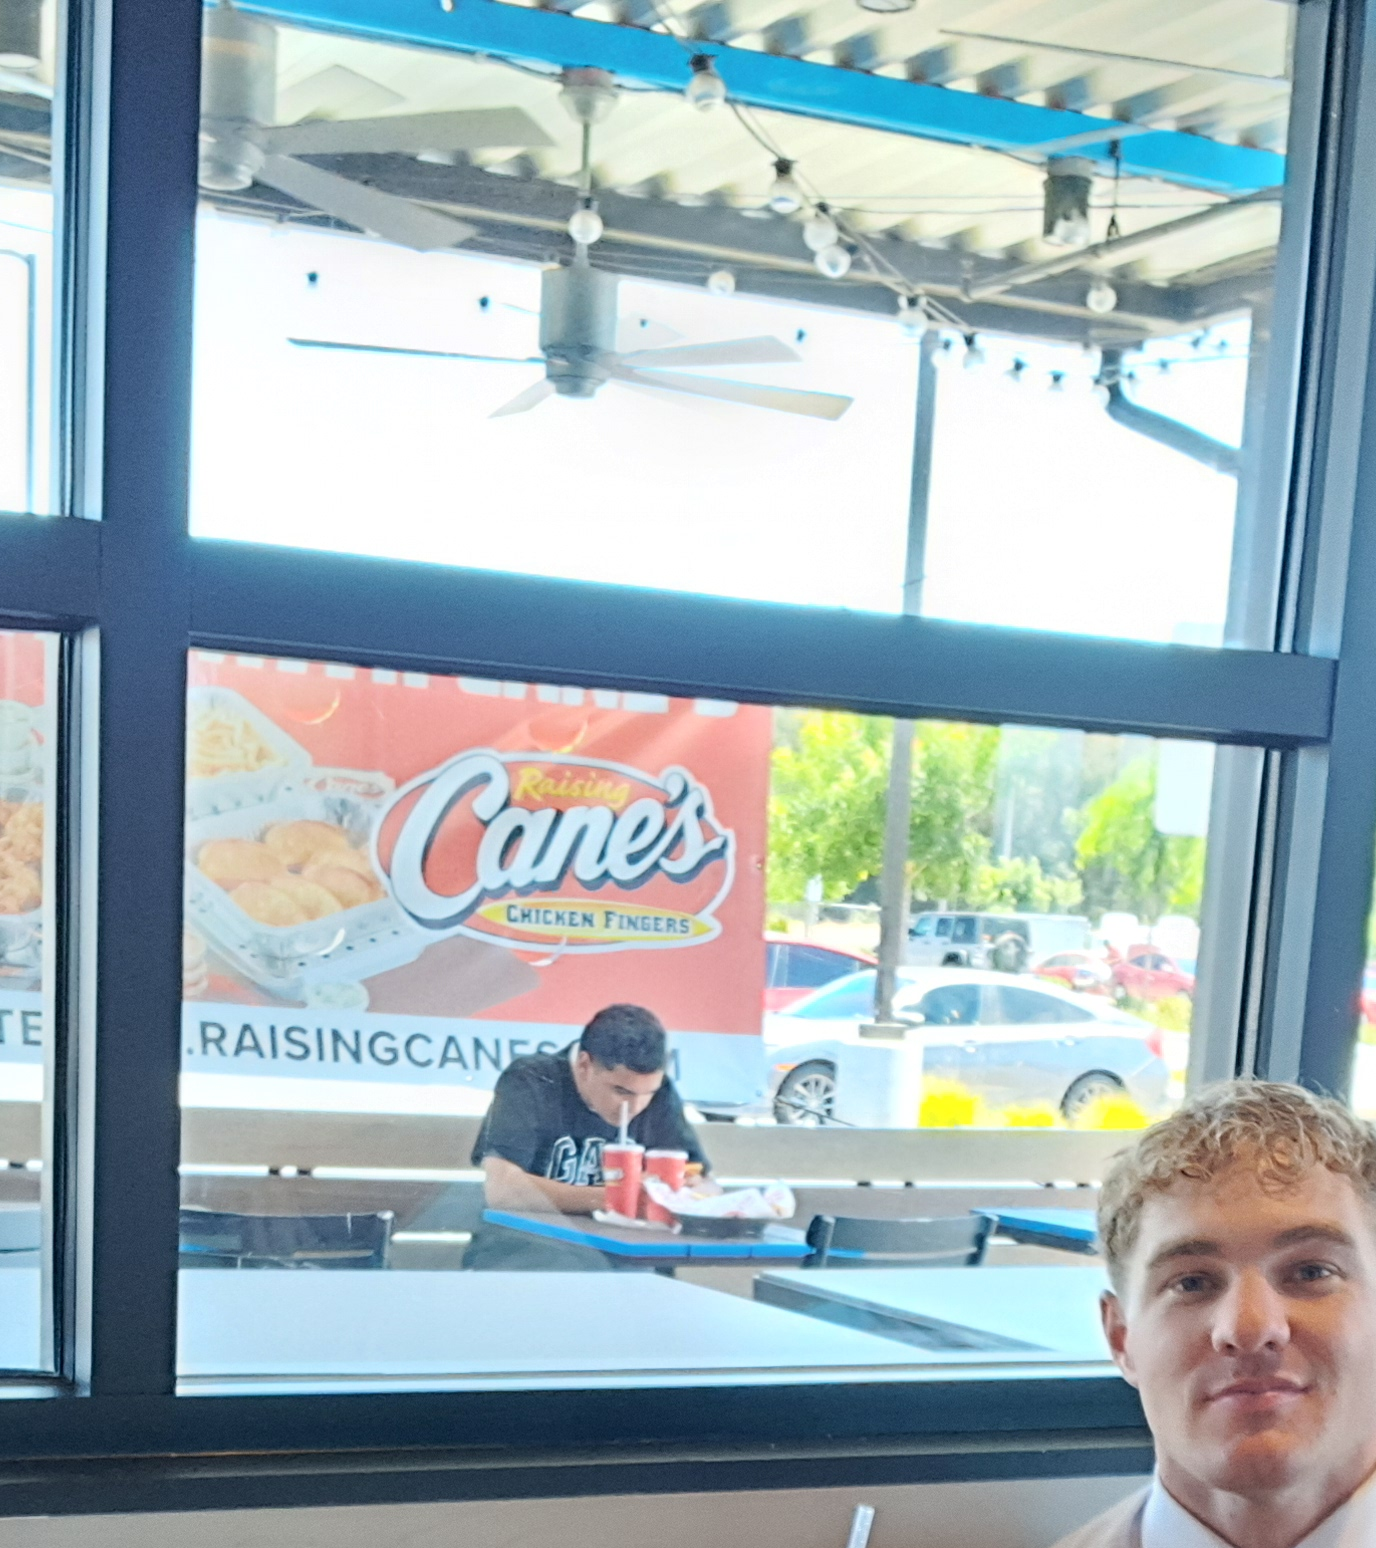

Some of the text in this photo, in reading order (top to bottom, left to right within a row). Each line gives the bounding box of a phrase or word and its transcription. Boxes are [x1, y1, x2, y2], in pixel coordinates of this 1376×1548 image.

[513, 767, 633, 811] Raising
[388, 754, 729, 924] Cane's
[506, 904, 690, 934] CHICKEN FINGERS
[546, 1136, 609, 1187] GA
